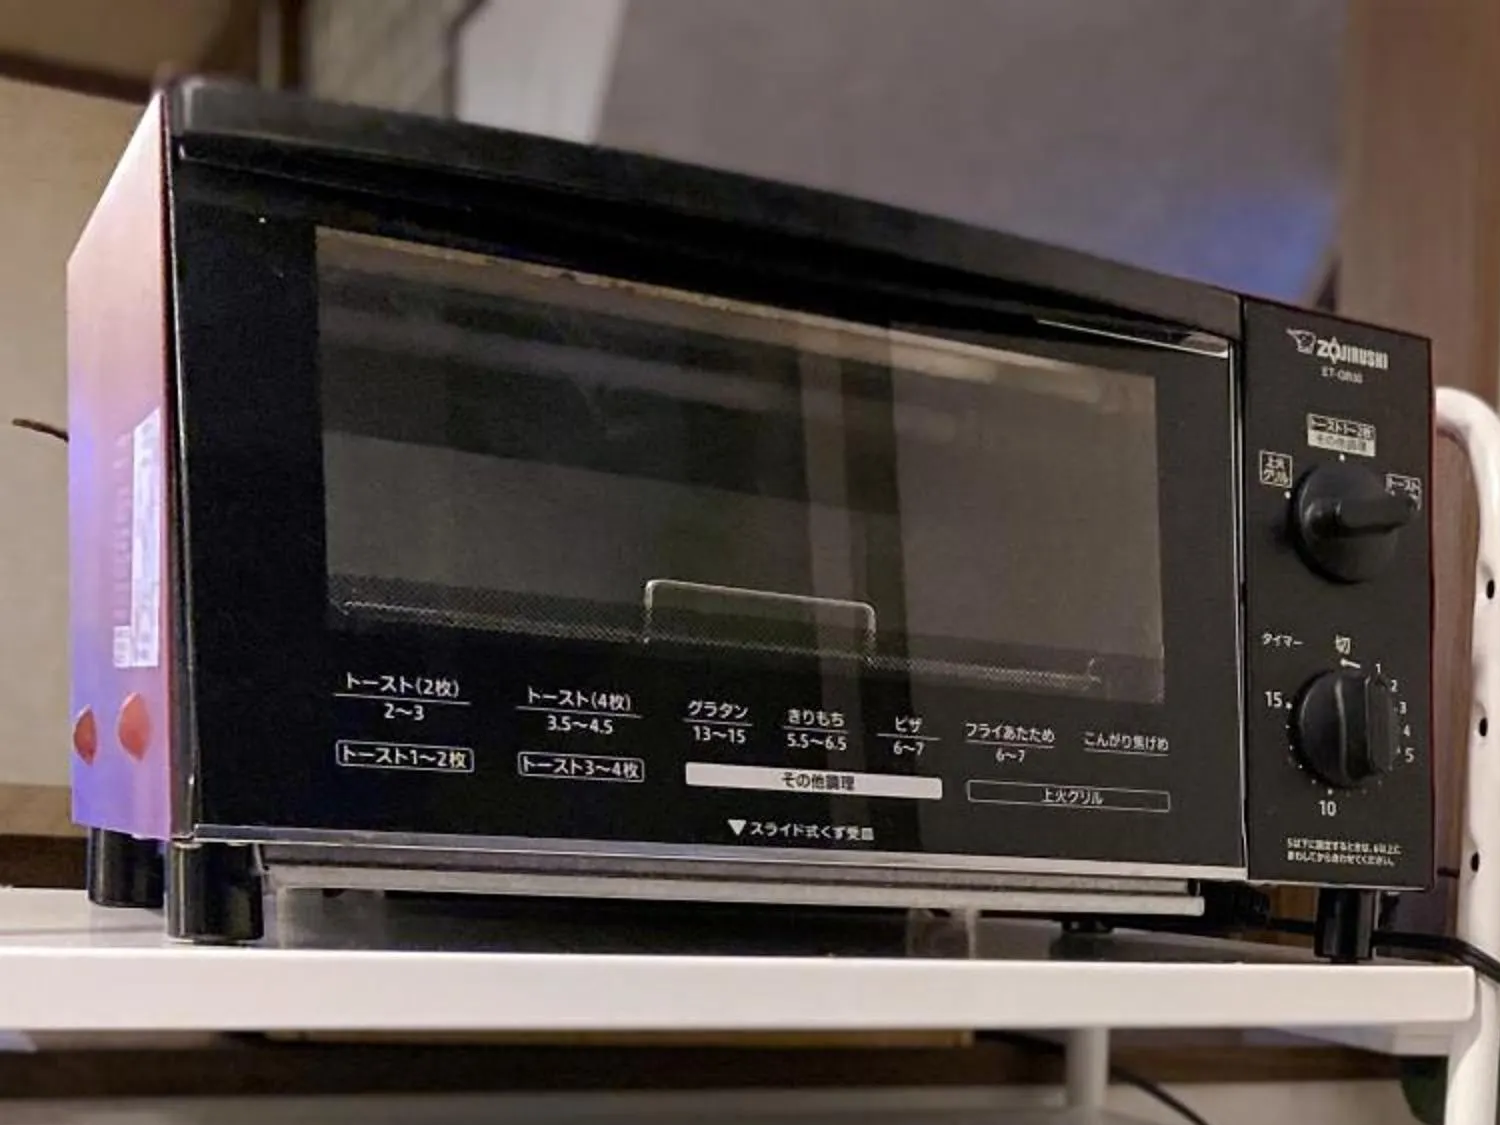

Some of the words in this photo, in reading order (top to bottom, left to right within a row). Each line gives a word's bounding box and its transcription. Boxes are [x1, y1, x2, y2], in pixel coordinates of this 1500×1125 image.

[1317, 335, 1389, 370] ZOJIRUSHI
[1262, 633, 1303, 648] タイマー
[1335, 634, 1351, 654] 切
[1375, 664, 1382, 674] 1
[346, 672, 460, 698] トースト(2枚)
[1391, 679, 1399, 693] 2
[527, 687, 631, 713] トースト(4枚)
[687, 699, 749, 719] グラタン
[1265, 691, 1283, 709] 15
[1399, 702, 1407, 714] 3
[788, 708, 844, 728] きりもち
[965, 721, 1056, 744] フライあたため
[1403, 725, 1411, 737] 4
[1405, 748, 1415, 763] 5
[782, 771, 855, 792] その他調理
[1042, 787, 1104, 807] 上火グリル
[1320, 801, 1337, 817] 10
